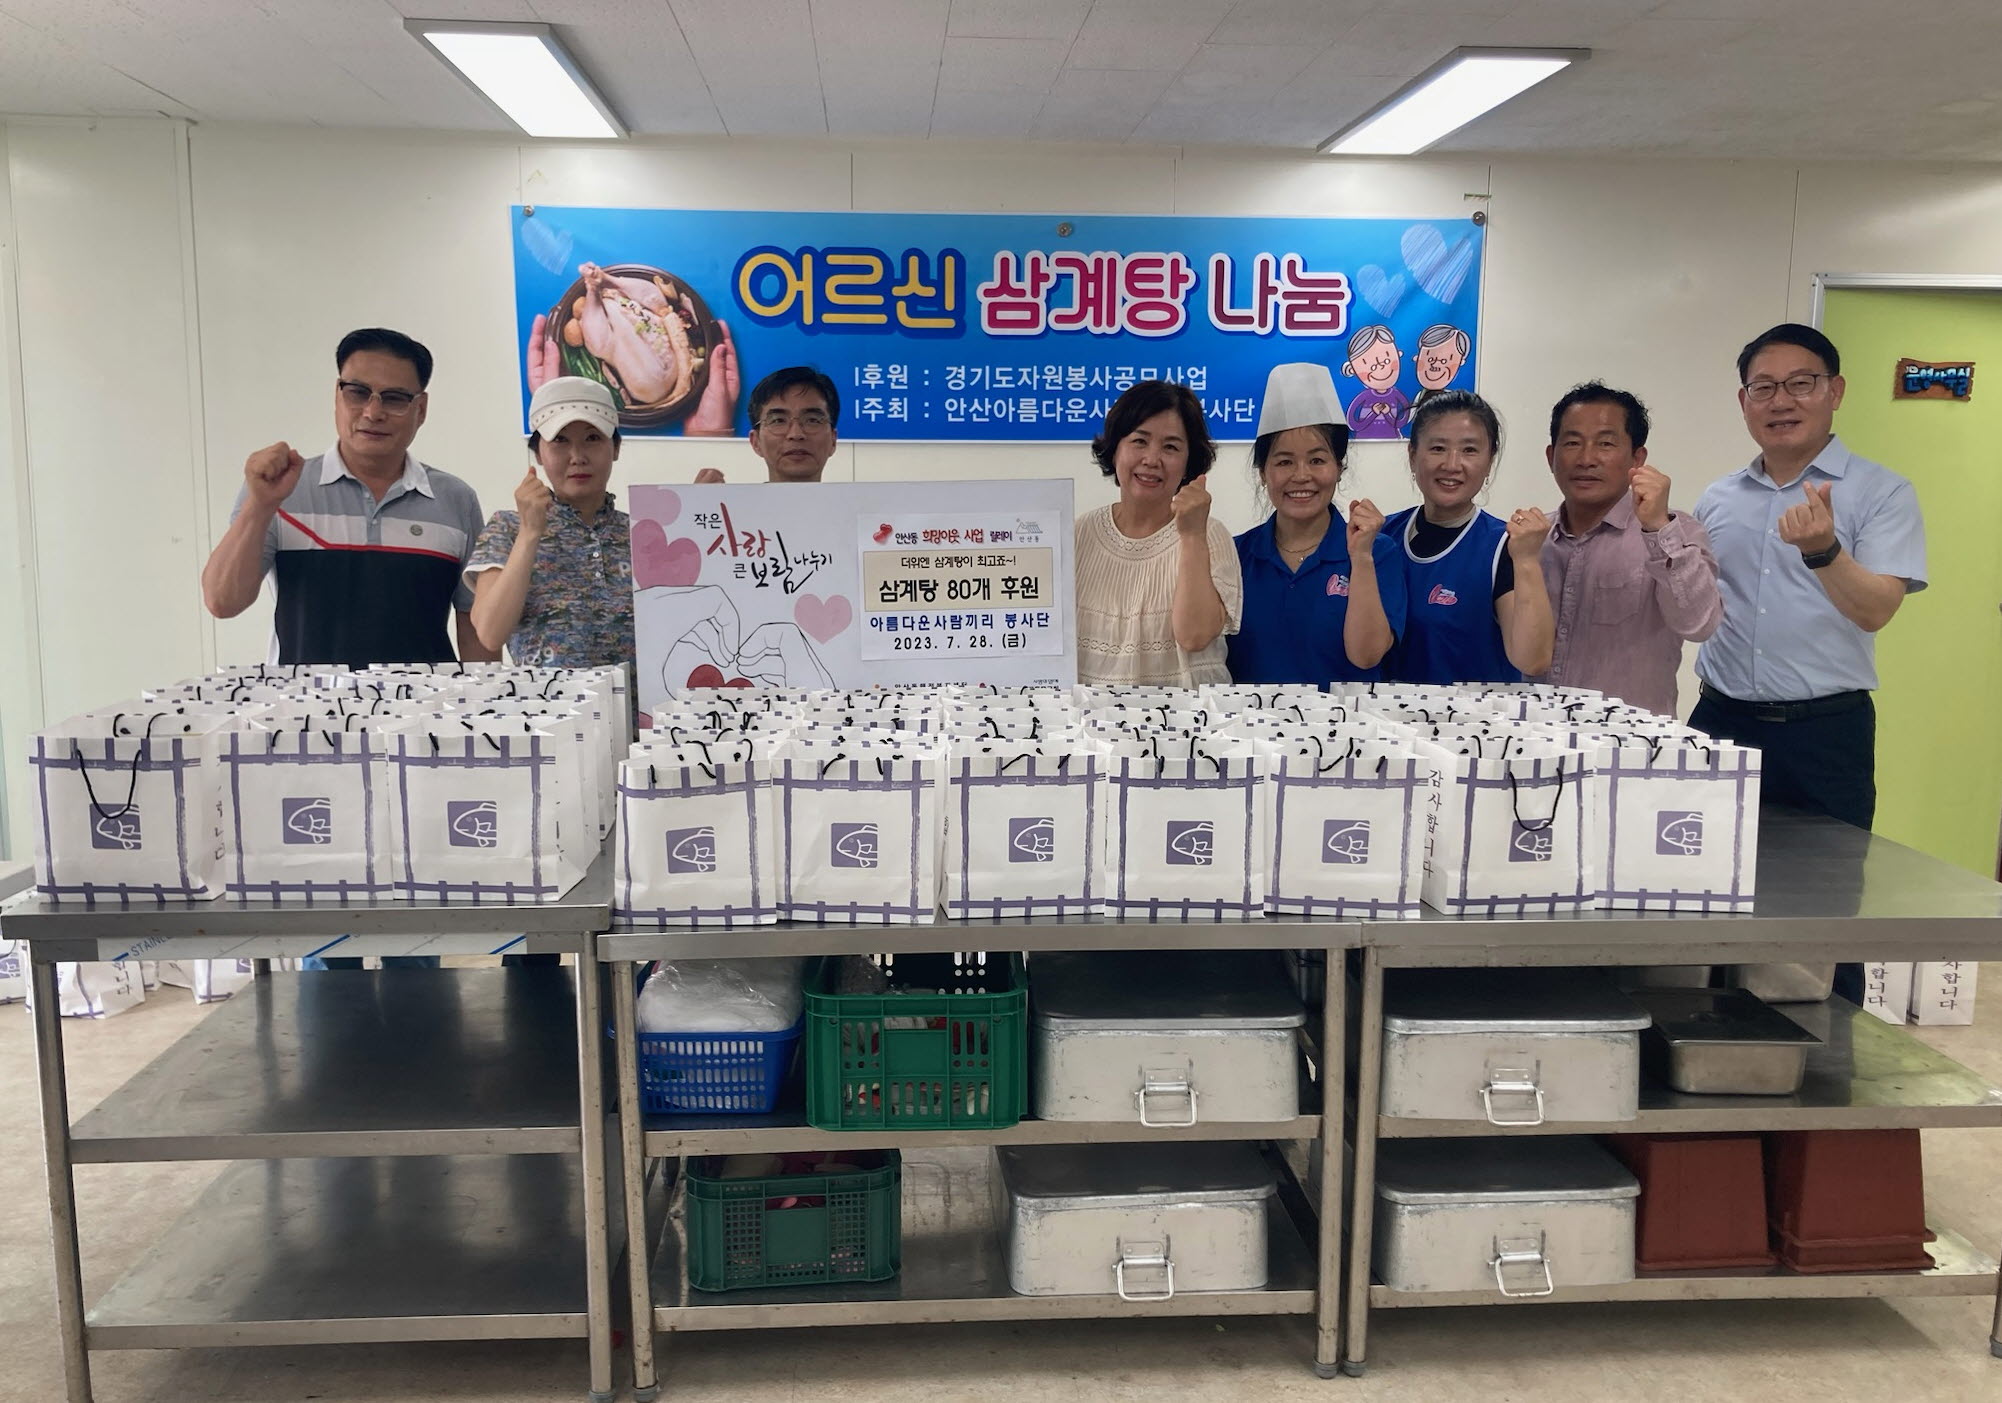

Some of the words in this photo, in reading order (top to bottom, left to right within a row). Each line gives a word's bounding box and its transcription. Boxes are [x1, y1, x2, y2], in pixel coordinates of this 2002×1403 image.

[736, 250, 960, 332] 어르신
[980, 252, 1193, 332] 삼계탕
[1211, 255, 1348, 333] 나눔
[861, 364, 908, 390] 후원
[861, 397, 908, 423] 주최
[694, 513, 722, 529] 작은
[707, 502, 771, 558] 사랑
[895, 533, 918, 545] 안산동
[922, 529, 960, 544] 희망이웃
[964, 528, 984, 543] 사업
[990, 531, 1012, 542] 릴레이
[733, 563, 747, 579] 큰
[751, 531, 814, 594] 보람
[794, 551, 832, 571] 나누기
[901, 557, 930, 569] 더위엔
[934, 556, 973, 568] 삼계탕이
[977, 555, 1016, 568] 최고죠~!
[879, 579, 938, 603] 삼계탕
[947, 578, 991, 601] 80개
[1001, 576, 1039, 600] 후원
[870, 614, 994, 632] 아름다운사람끼리
[1004, 612, 1050, 629] 봉사단
[894, 636, 938, 650] 2023.
[947, 636, 960, 649] 7.
[969, 635, 993, 648] 28.
[1002, 633, 1027, 649] (금)
[1423, 769, 1444, 879] 감사합니다
